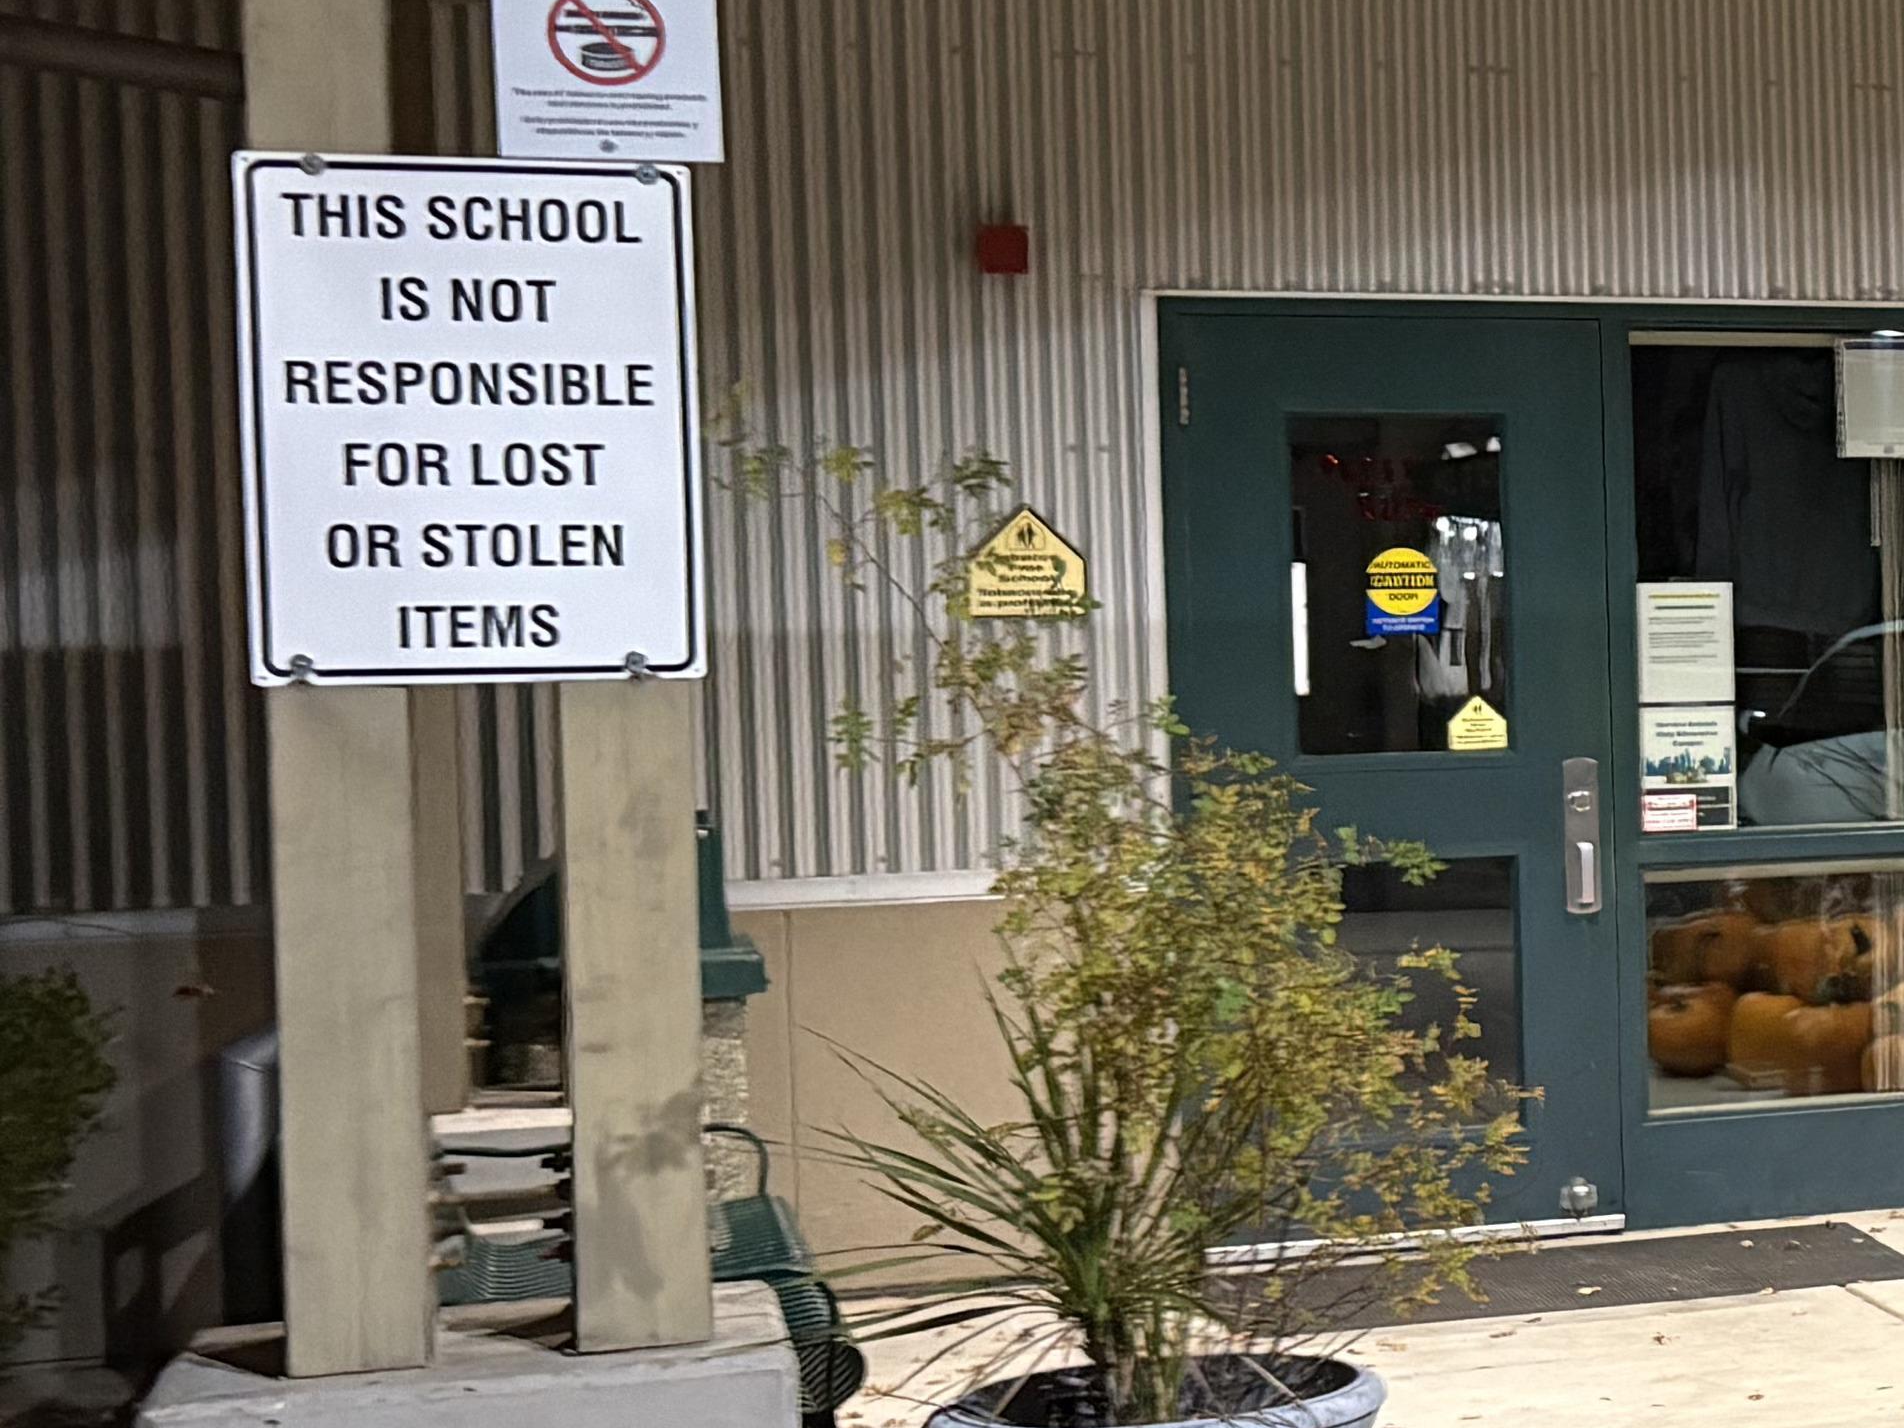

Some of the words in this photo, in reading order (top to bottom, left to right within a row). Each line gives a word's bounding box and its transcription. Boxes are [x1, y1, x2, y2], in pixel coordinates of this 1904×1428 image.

[281, 191, 407, 241] THIS
[426, 195, 642, 246] SCHOOL
[380, 276, 429, 323] IS
[451, 278, 557, 324] NOT
[284, 359, 656, 408] RESPONSIBLE
[343, 441, 450, 488] FOR
[471, 441, 606, 488] LOST
[326, 522, 402, 569] OR
[421, 523, 626, 569] STOLEN
[1372, 560, 1431, 569] AUTOMATIC
[1370, 574, 1435, 587] CAUTION
[1388, 592, 1419, 601] DOOR
[398, 602, 561, 650] ITEMS
